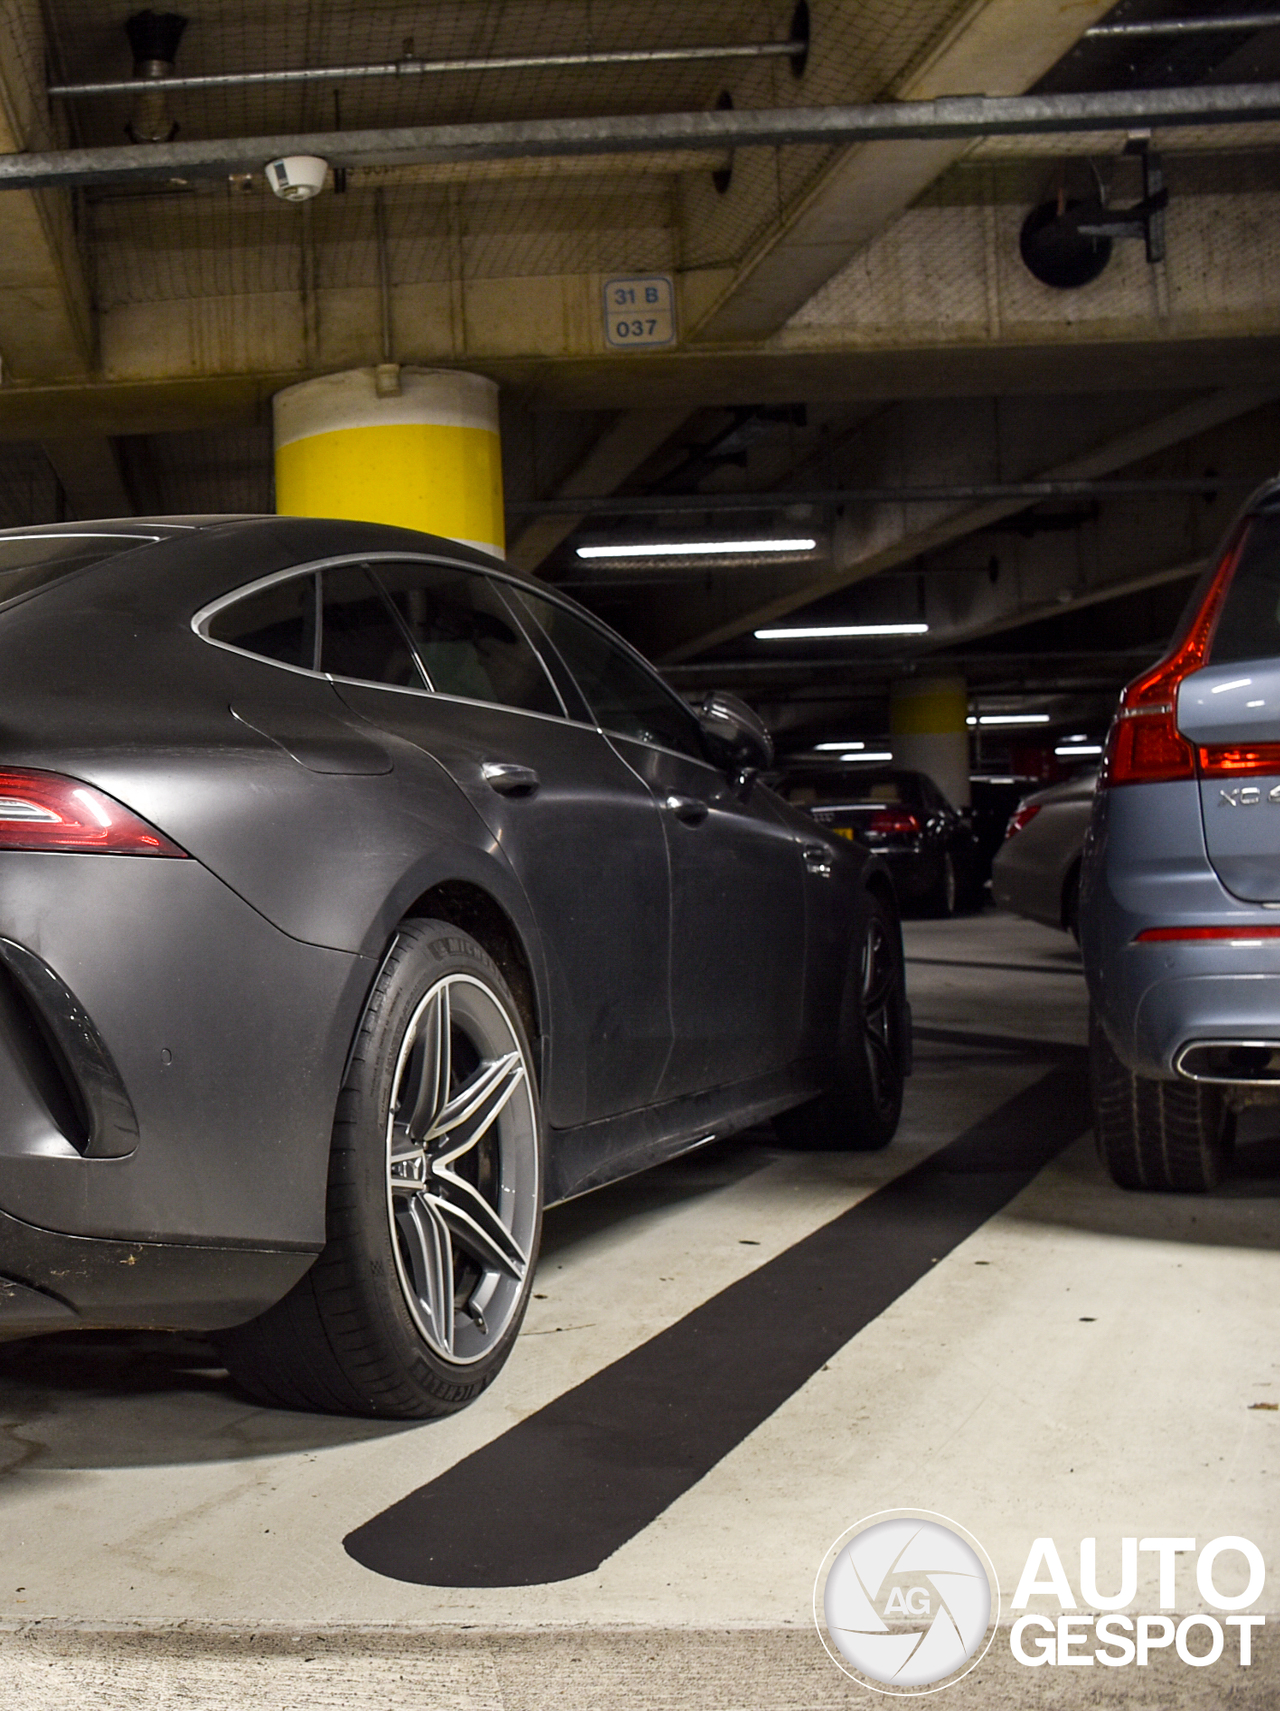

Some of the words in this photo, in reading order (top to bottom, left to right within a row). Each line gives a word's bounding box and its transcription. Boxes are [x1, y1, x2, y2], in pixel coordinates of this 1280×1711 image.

[614, 288, 636, 305] 31
[645, 287, 659, 303] B
[616, 319, 657, 338] 037
